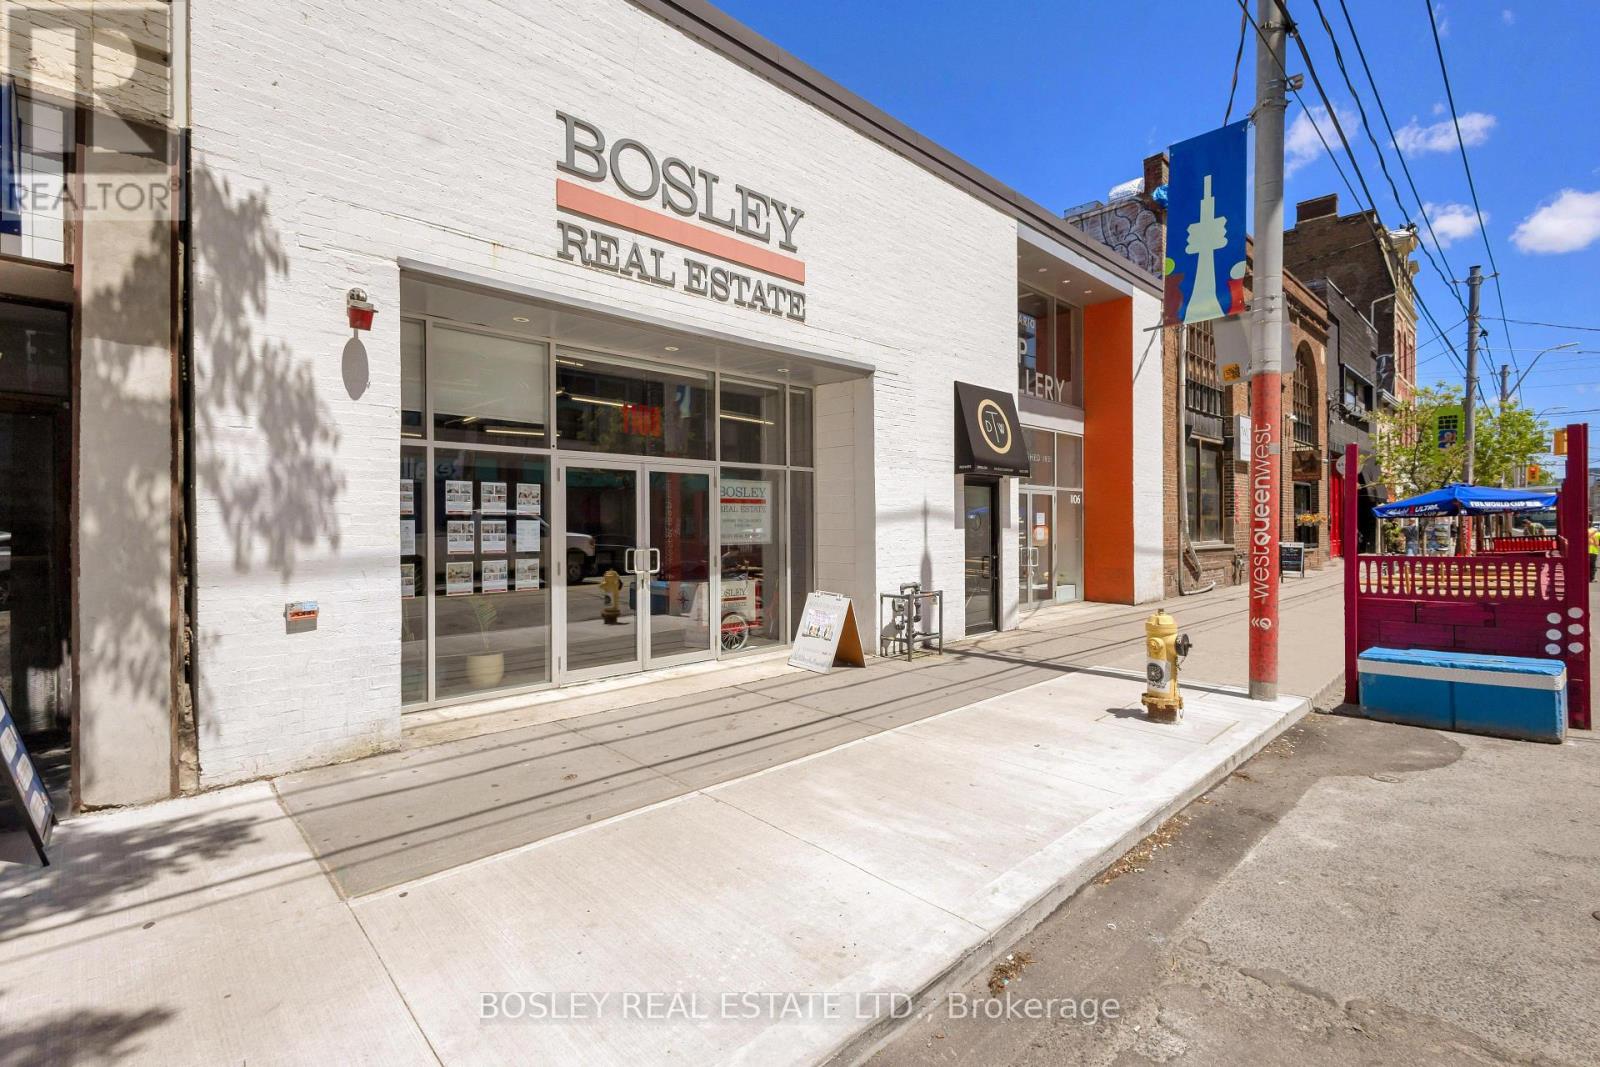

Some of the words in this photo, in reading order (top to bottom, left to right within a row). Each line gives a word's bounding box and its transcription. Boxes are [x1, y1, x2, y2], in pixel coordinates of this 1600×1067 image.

[556, 110, 804, 252] BOSLEY
[557, 219, 675, 287] REAL
[684, 257, 806, 321] ESTATE
